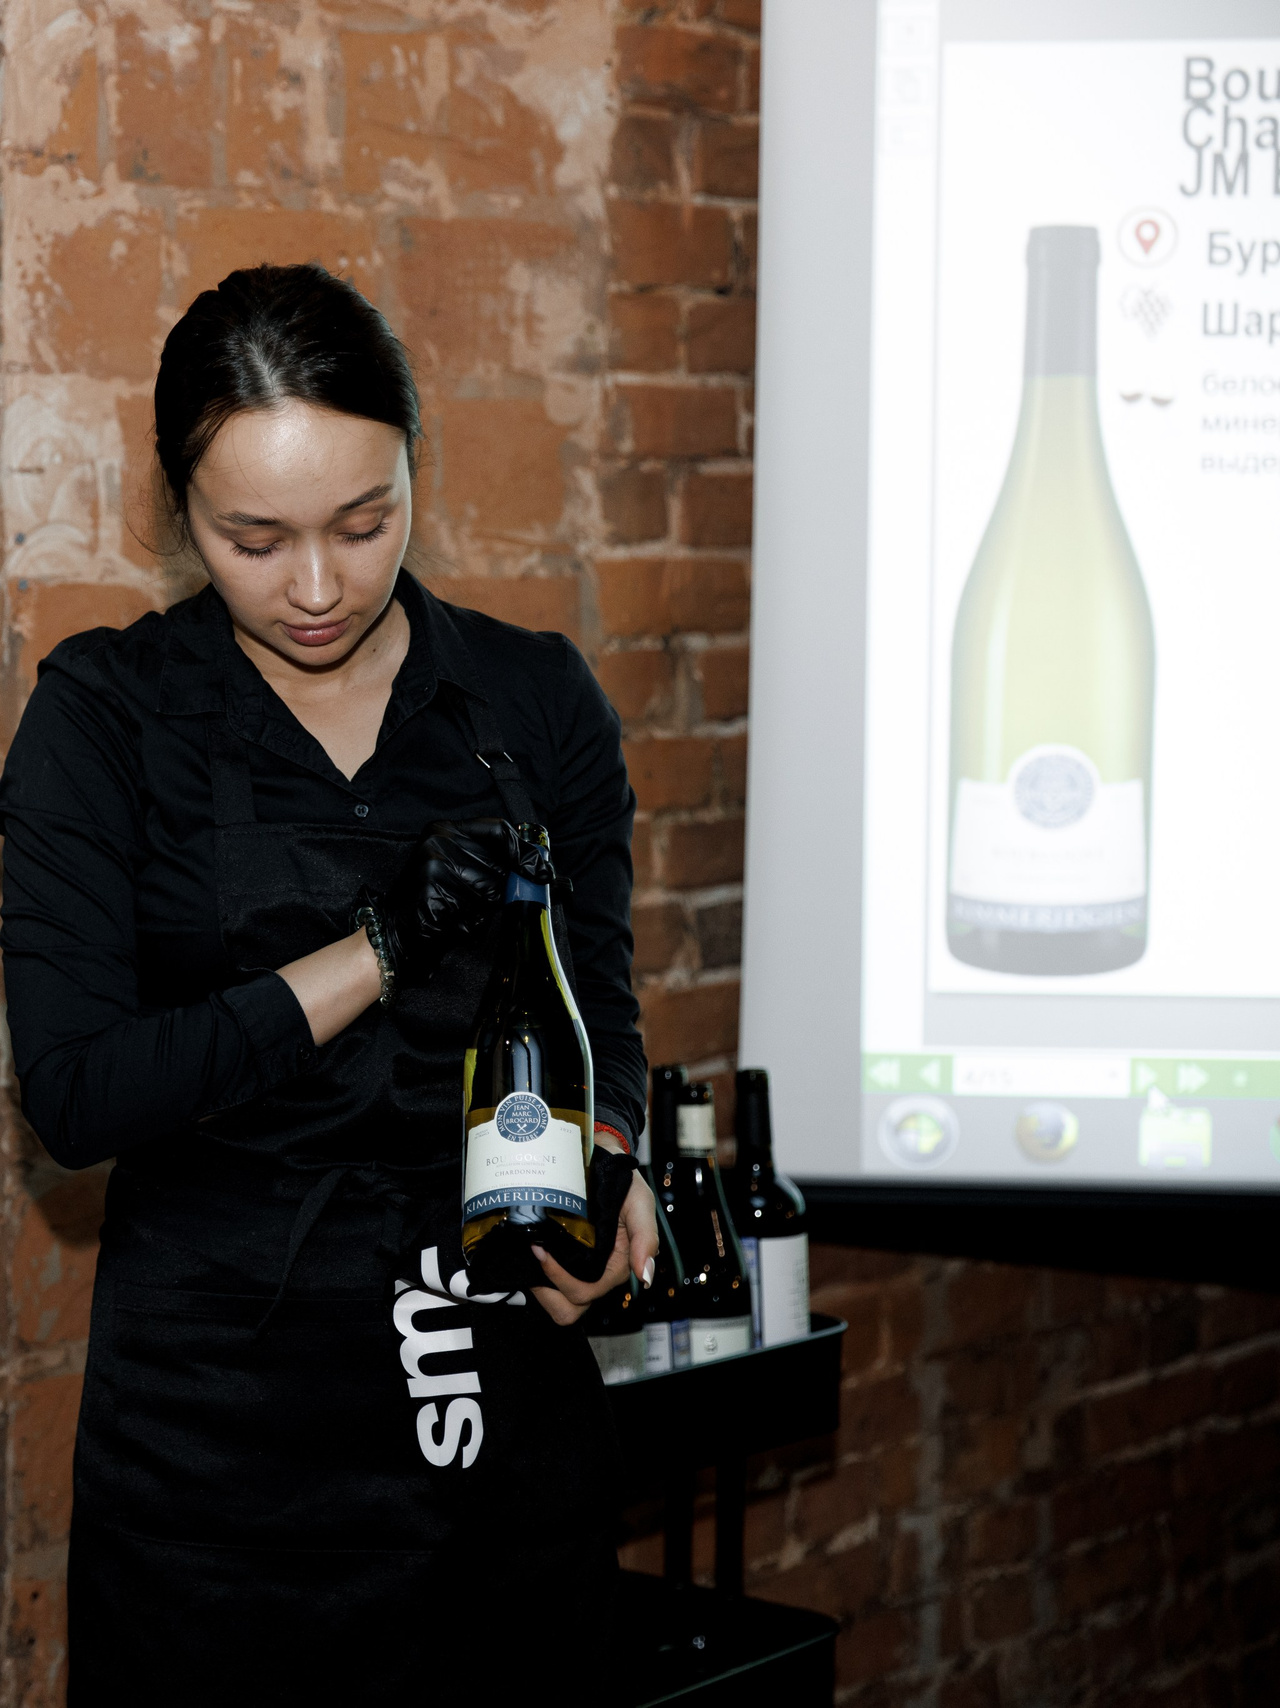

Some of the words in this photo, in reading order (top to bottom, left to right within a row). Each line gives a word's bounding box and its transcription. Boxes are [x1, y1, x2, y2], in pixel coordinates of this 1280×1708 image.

[1179, 148, 1248, 197] JM
[1208, 230, 1280, 276] Бур
[1202, 370, 1280, 396] бело
[1202, 416, 1280, 436] мине
[500, 1099, 513, 1112] VIN
[486, 1153, 557, 1166] BOUGOGNE
[494, 1169, 546, 1177] CHARDONNAY
[466, 1191, 582, 1215] KIMMERIDGIEN
